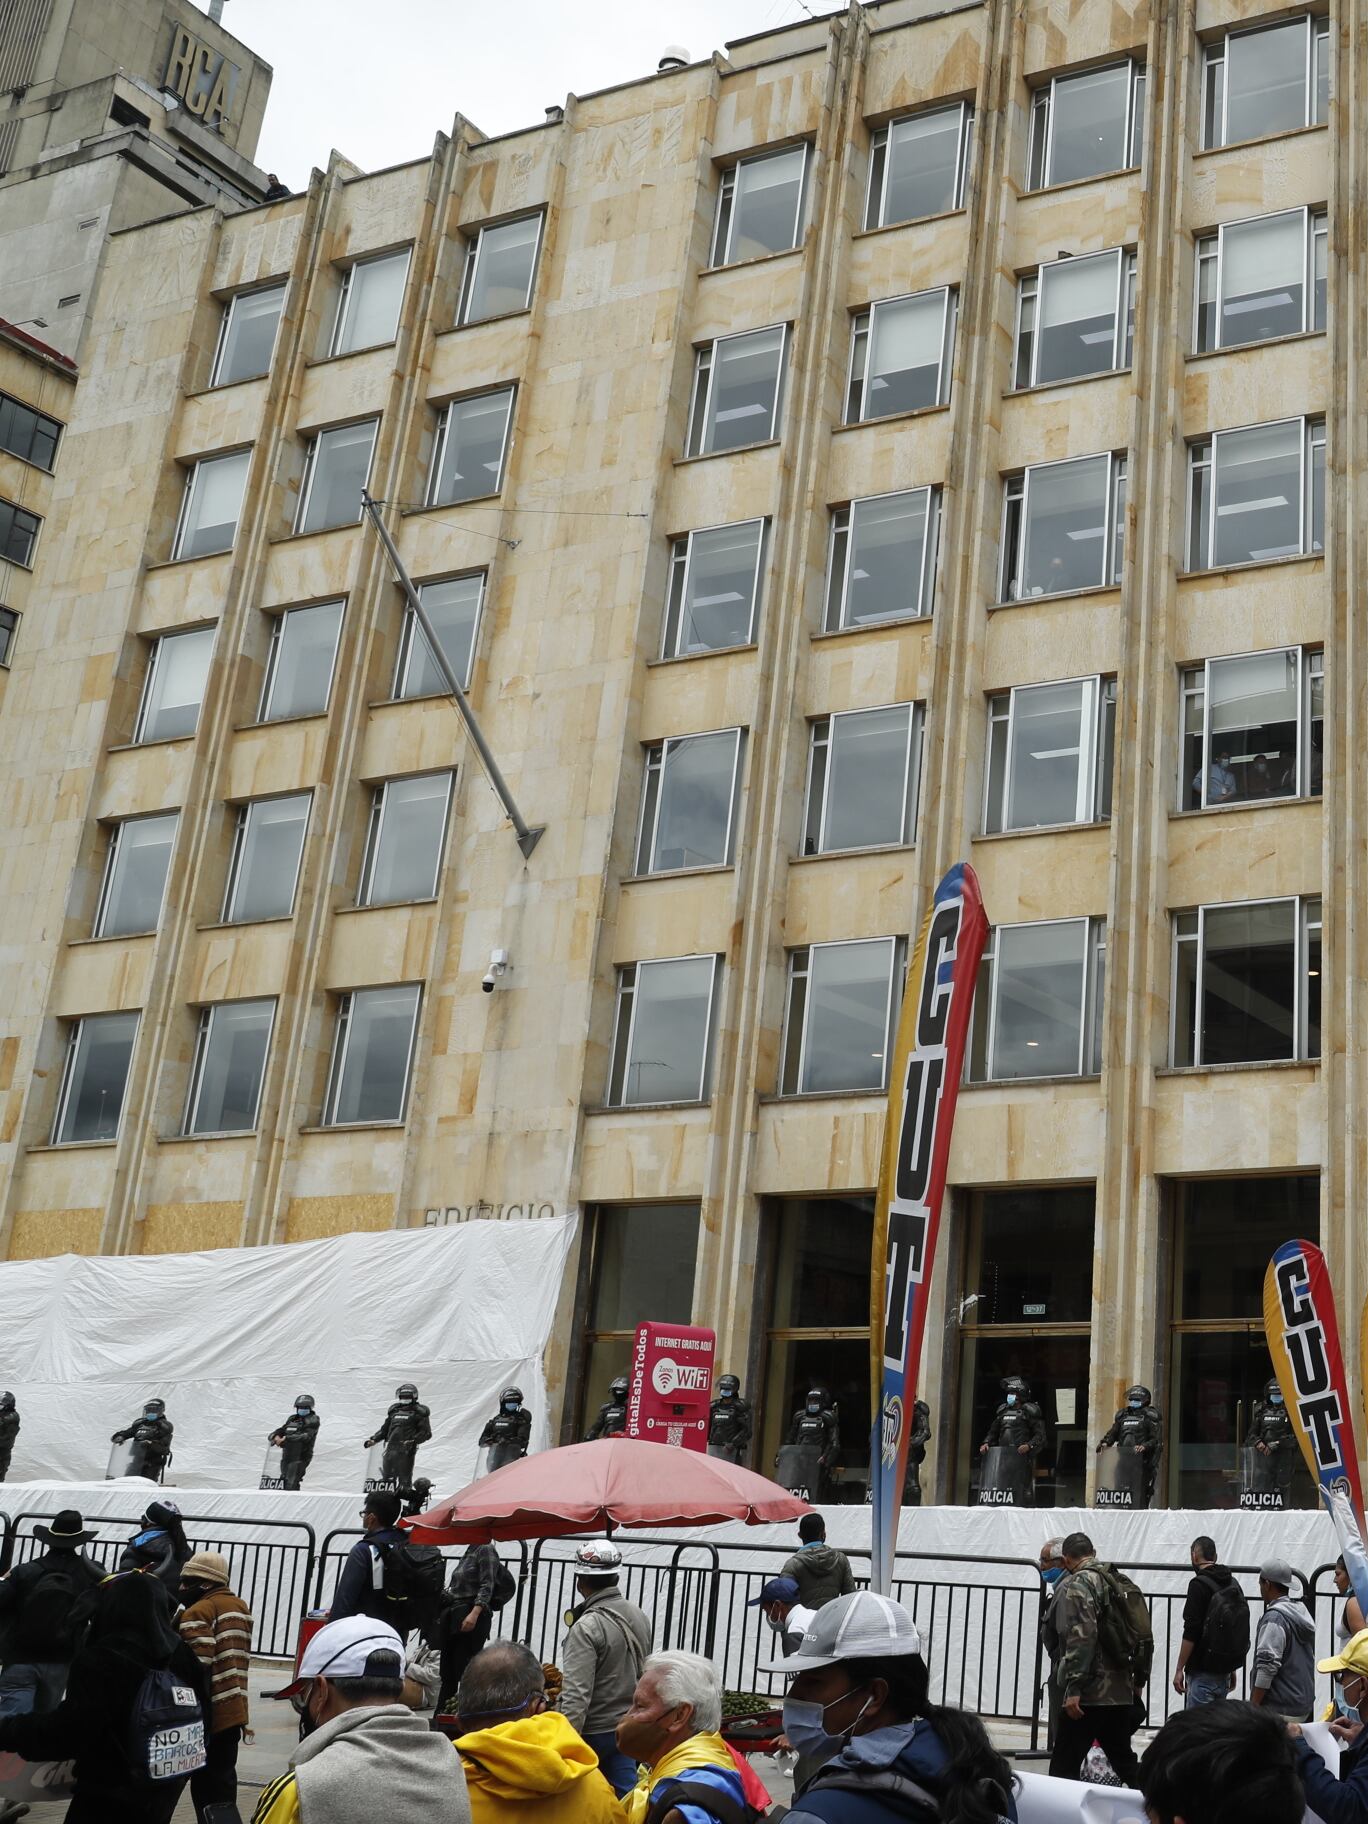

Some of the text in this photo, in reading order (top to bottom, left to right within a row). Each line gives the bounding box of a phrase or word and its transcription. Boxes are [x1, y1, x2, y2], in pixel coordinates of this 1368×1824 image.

[883, 895, 964, 1374] CUT
[655, 1337, 681, 1349] INTERNET
[682, 1339, 699, 1351] GRATIS
[1274, 1254, 1343, 1470] CUT
[628, 1329, 648, 1436] gitalEsDeTodos
[677, 1368, 707, 1388] WiFi
[260, 1479, 285, 1490] OLICIA
[364, 1480, 395, 1493] POLICIA
[788, 1488, 810, 1501] ICIA
[979, 1490, 1014, 1504] POLICIA
[1096, 1491, 1132, 1504] POLICIA
[1240, 1493, 1283, 1506] POLICIA
